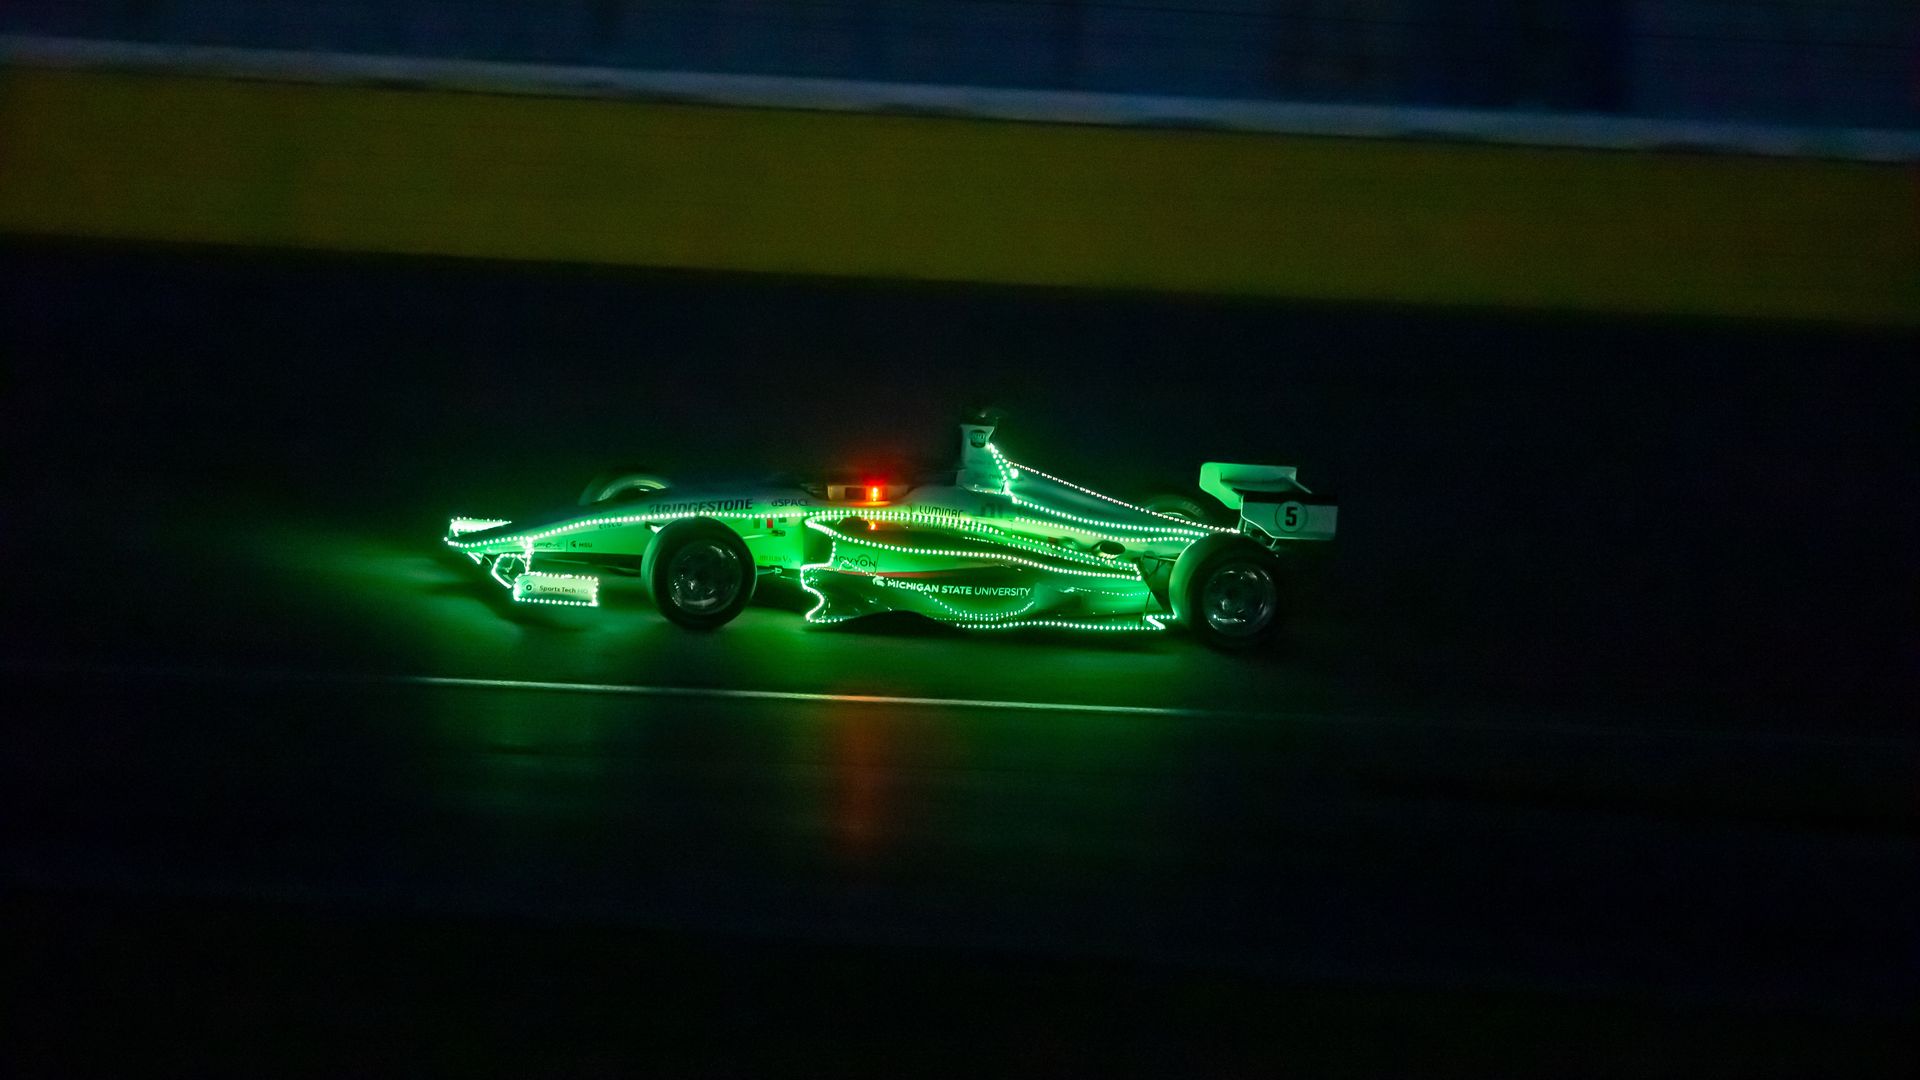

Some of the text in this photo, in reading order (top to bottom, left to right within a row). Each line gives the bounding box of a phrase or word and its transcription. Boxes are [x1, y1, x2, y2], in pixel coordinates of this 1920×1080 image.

[649, 499, 753, 514] BRIDGESTONE
[1285, 506, 1298, 526] 5
[539, 585, 560, 593] Sports
[562, 586, 576, 594] Tech
[887, 580, 1031, 597] MICHIGAN STATE UNIVERSITY
